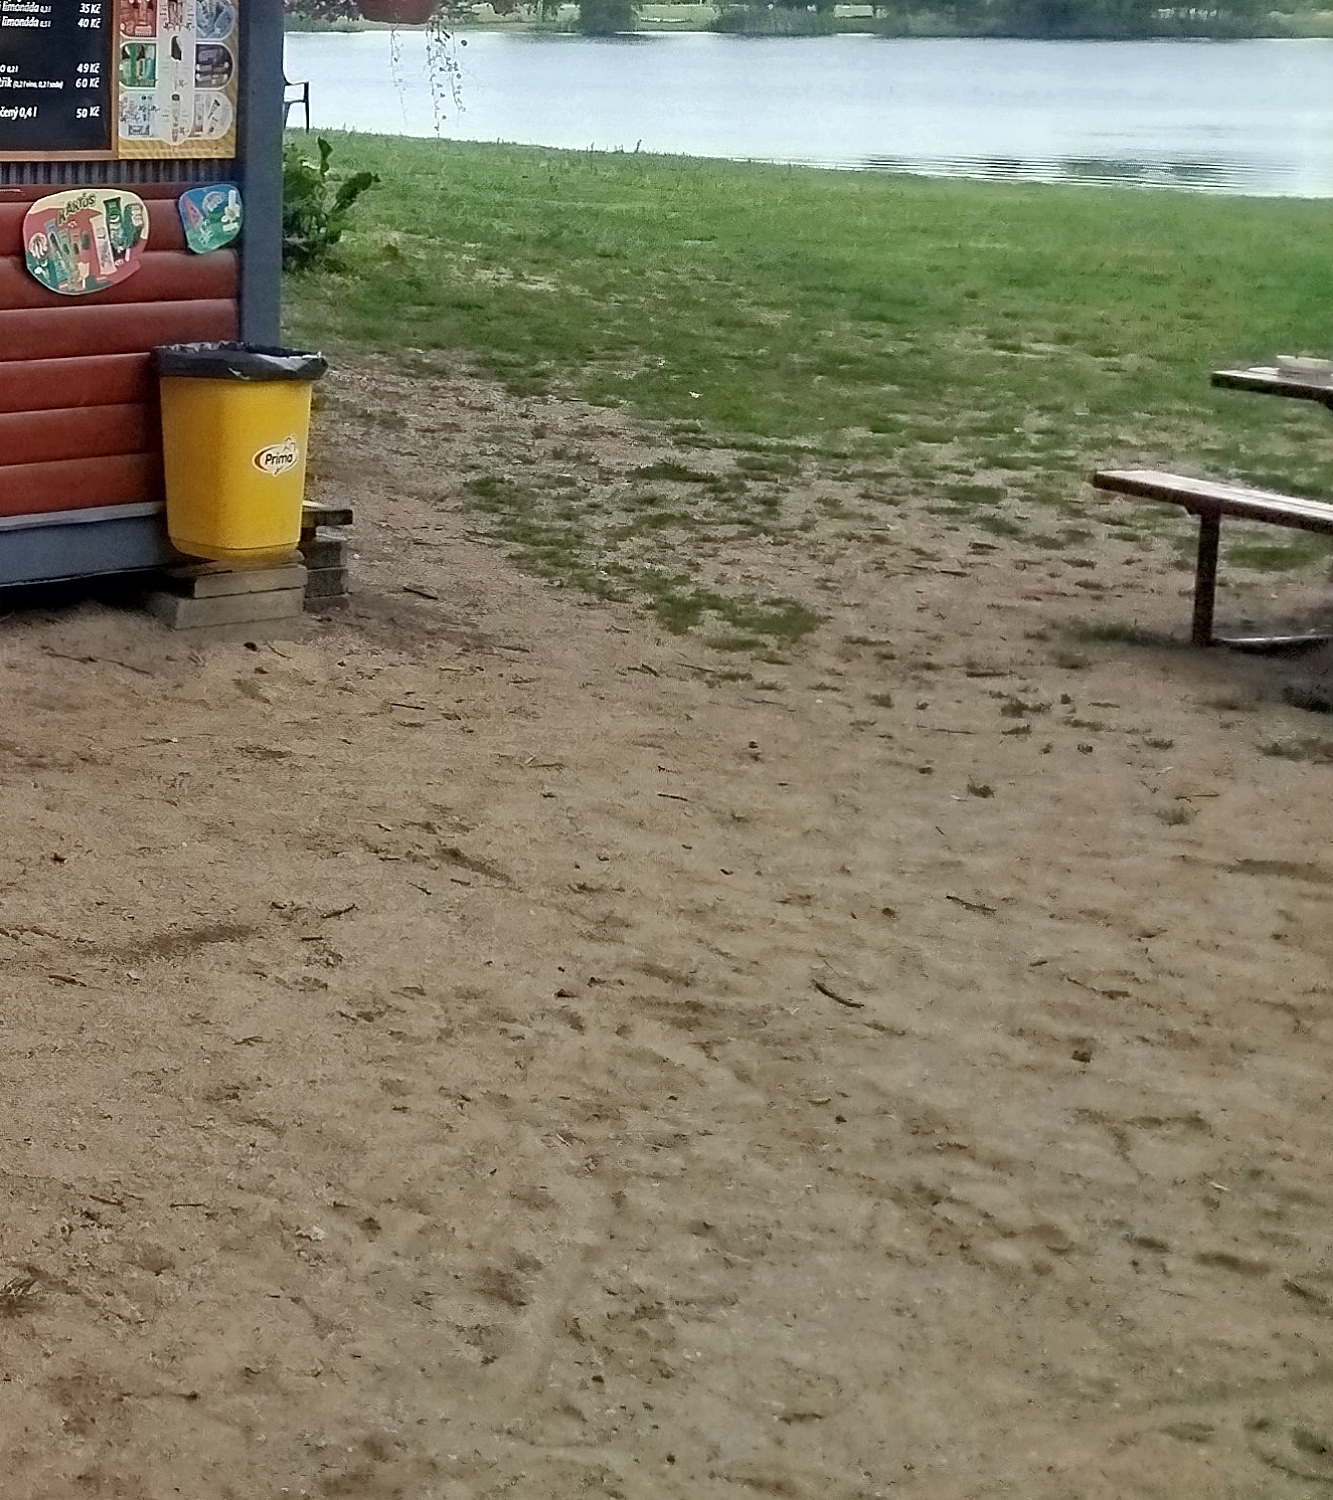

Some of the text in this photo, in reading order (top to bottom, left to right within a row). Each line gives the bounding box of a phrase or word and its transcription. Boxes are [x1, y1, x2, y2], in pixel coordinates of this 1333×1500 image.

[2, 1, 40, 12] limonáda
[79, 3, 91, 14] 35
[90, 3, 102, 14] Kč
[19, 107, 32, 119] 0,4
[76, 108, 88, 118] 50
[89, 106, 100, 117] Kč
[264, 452, 293, 465] Prima
